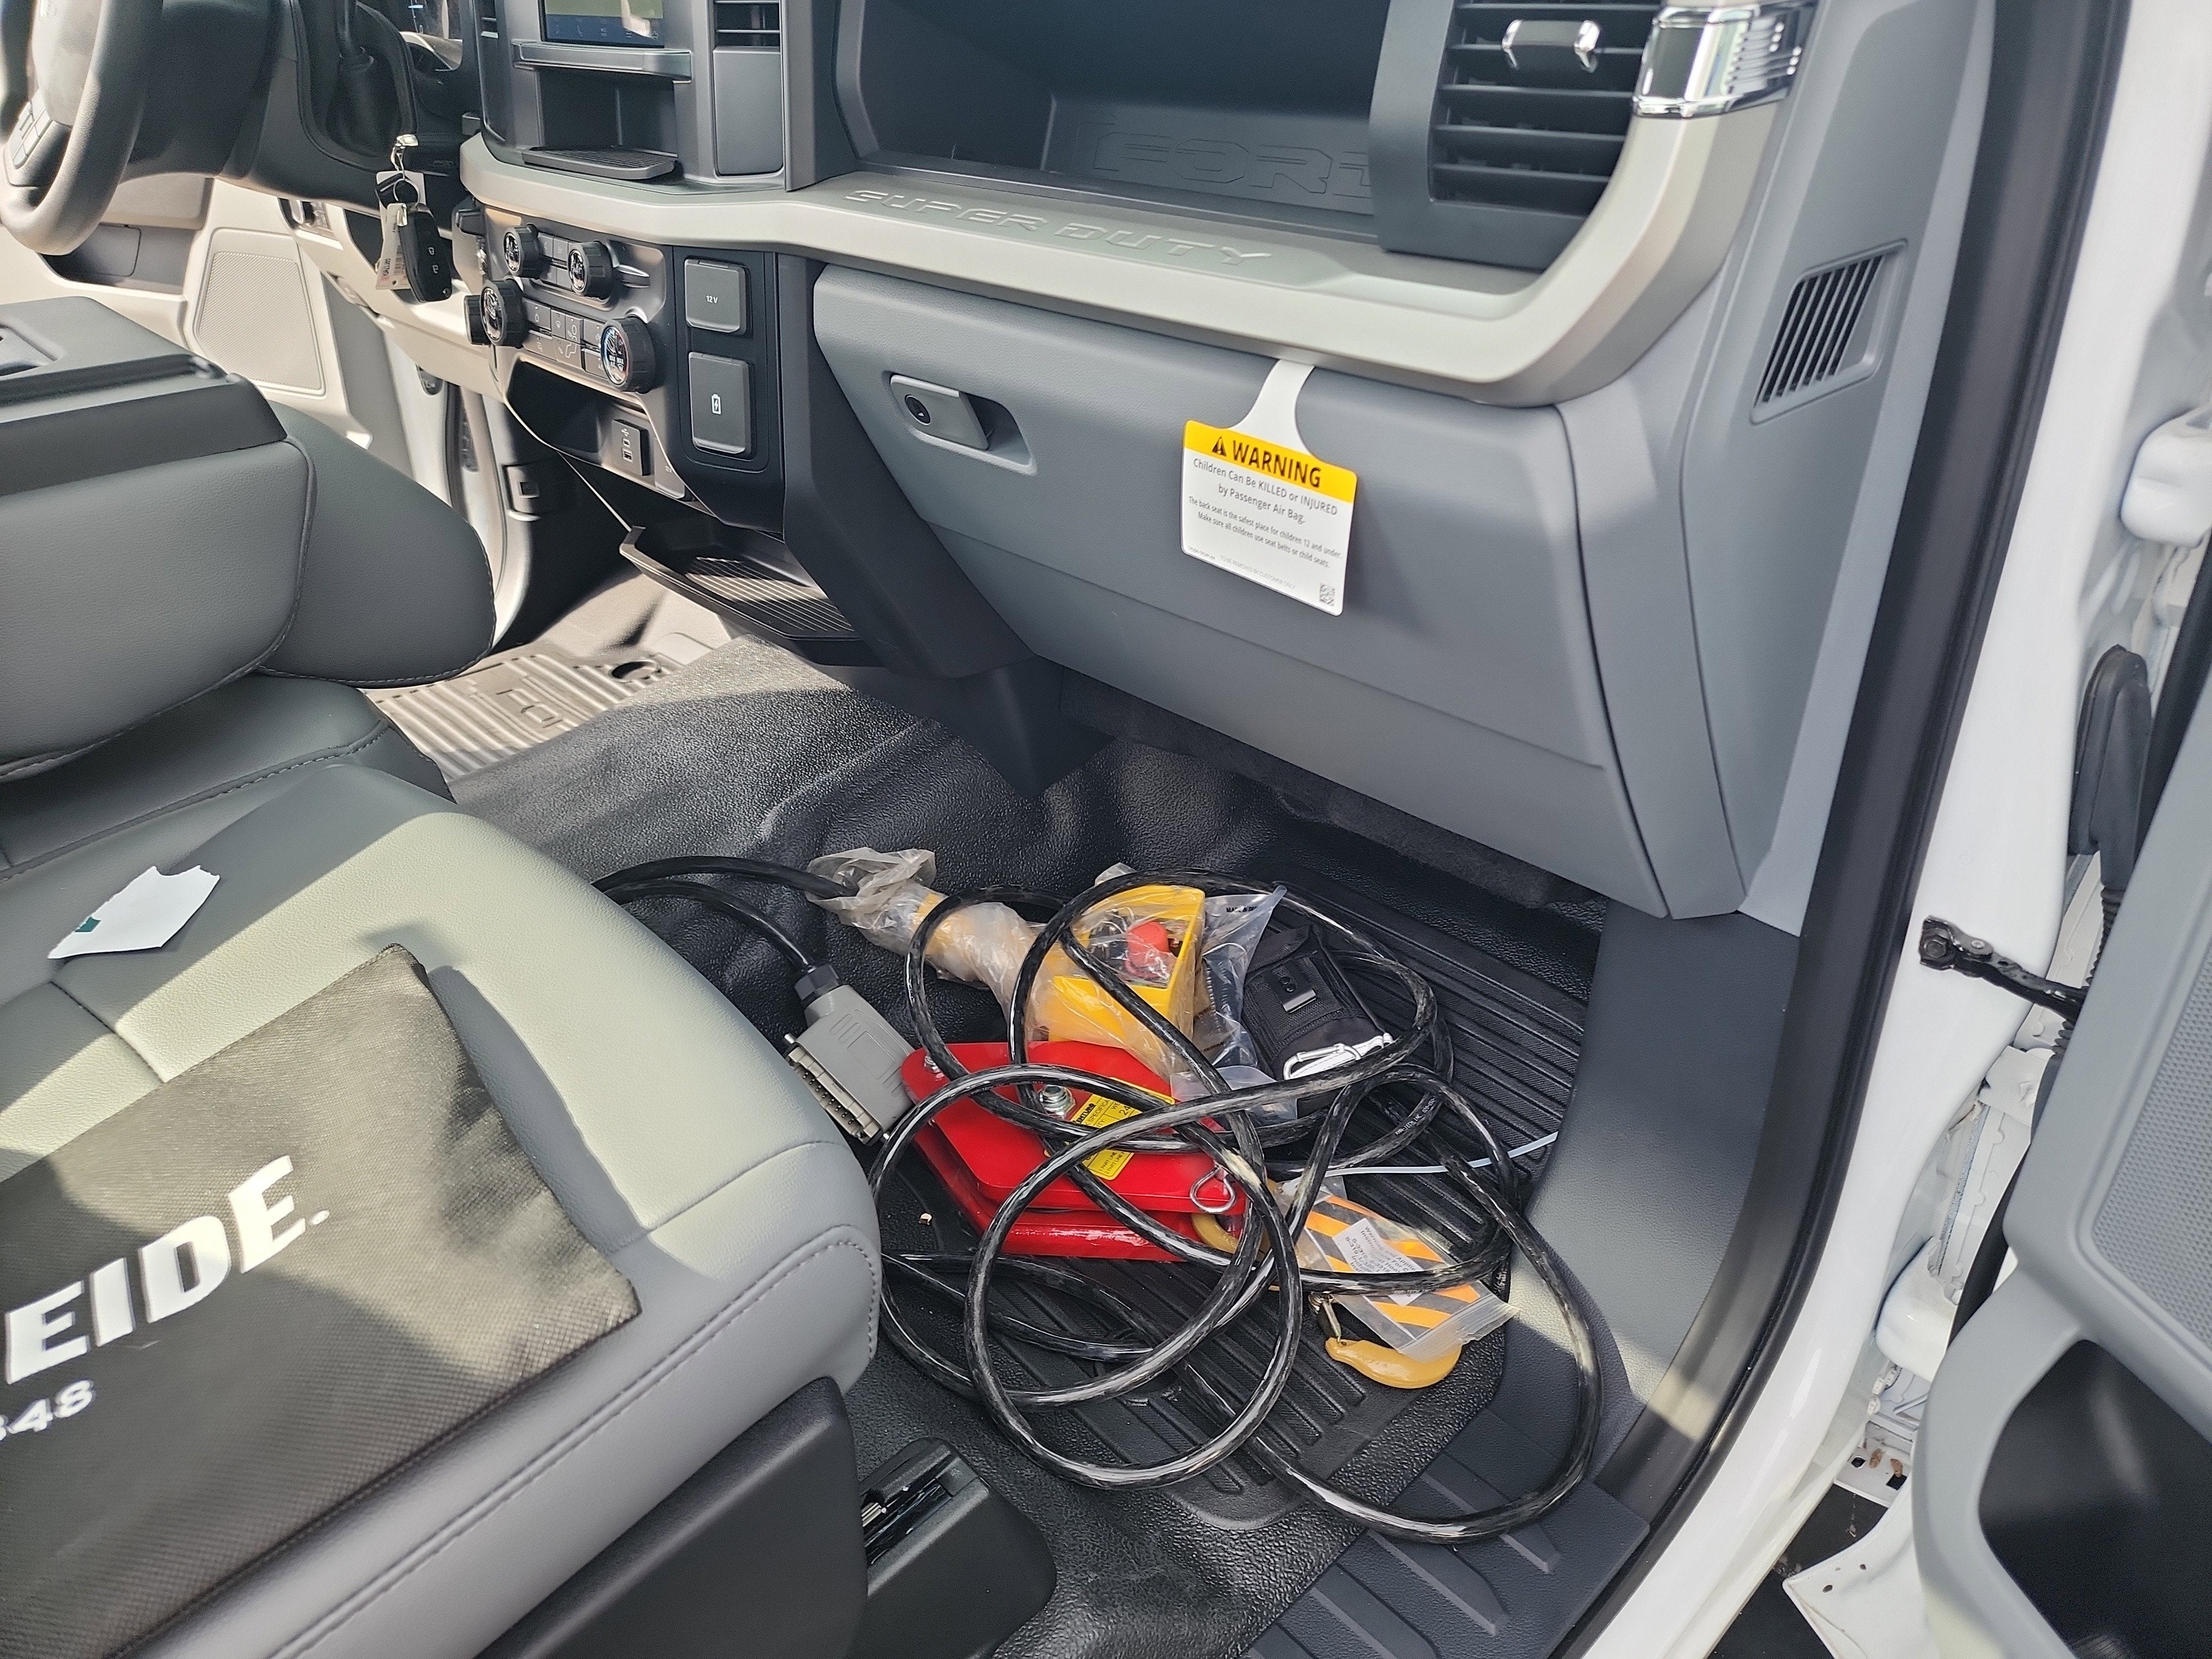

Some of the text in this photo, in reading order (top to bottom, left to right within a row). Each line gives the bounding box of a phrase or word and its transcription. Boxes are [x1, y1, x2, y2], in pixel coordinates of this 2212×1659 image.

[844, 190, 1273, 265] SUPER DUTY
[706, 295, 718, 304] 12V
[1194, 458, 1338, 515] Children Can Be KILLED or INJURED
[1233, 440, 1321, 488] WARNING
[1218, 483, 1228, 497] by
[1230, 488, 1271, 510] Passenger
[1273, 504, 1286, 515] Air
[1189, 495, 1197, 505] The
[1199, 499, 1211, 510] back
[1212, 506, 1222, 515] seat
[1229, 512, 1238, 520] the
[1239, 516, 1254, 526] safest
[1255, 521, 1269, 532] place
[1280, 531, 1302, 544] children
[1303, 539, 1310, 547] 12
[1311, 543, 1322, 552] and
[1198, 511, 1212, 523] Make
[1213, 519, 1224, 528] sure
[1232, 525, 1253, 539] children
[1254, 534, 1264, 543] use
[1265, 539, 1276, 548] seat
[1277, 541, 1291, 553] belts
[1299, 550, 1313, 561] child
[1072, 1102, 1097, 1124] ENTURO
[1087, 1099, 1110, 1123] SPECIFICA
